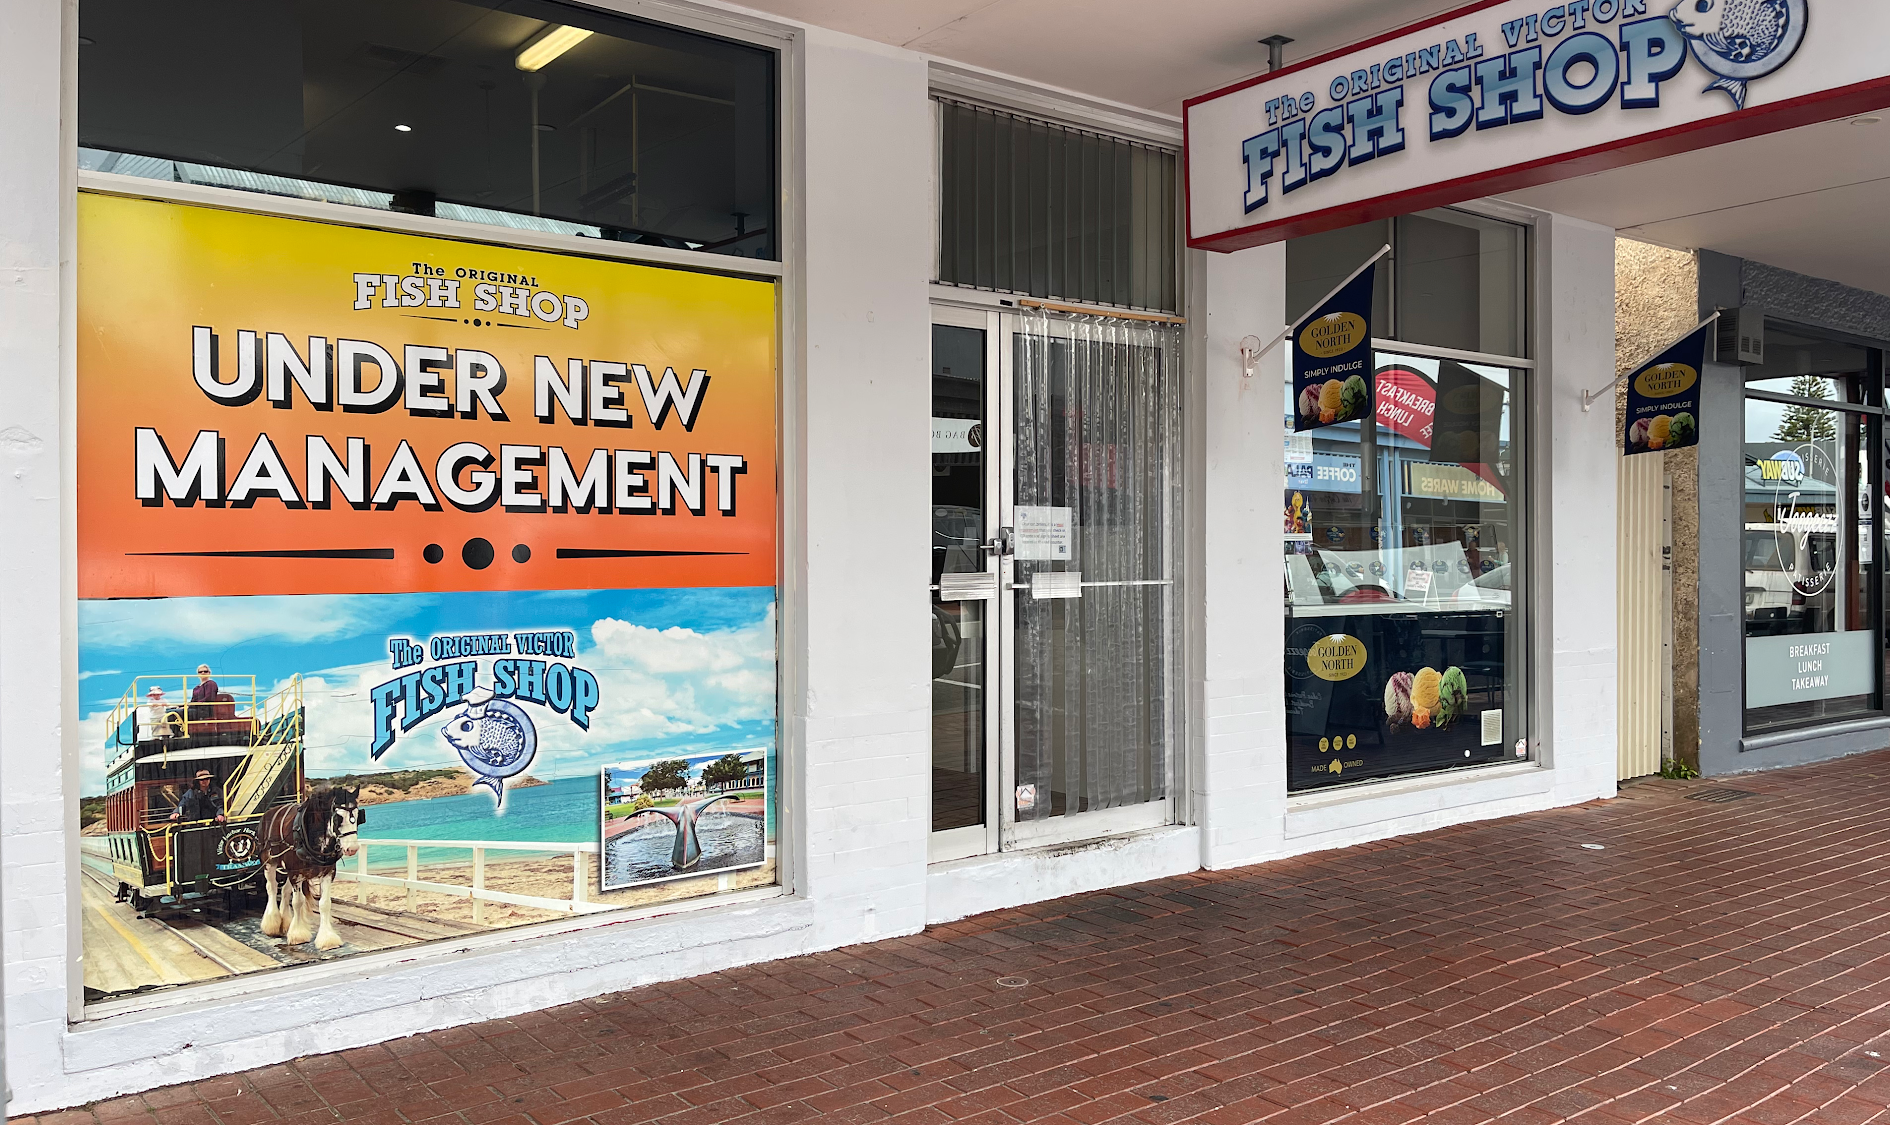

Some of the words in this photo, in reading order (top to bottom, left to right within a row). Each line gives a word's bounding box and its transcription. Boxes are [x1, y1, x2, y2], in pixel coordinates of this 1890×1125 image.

[1264, 93, 1316, 125] The
[1329, 33, 1484, 98] ORIGINAL
[1501, 0, 1647, 48] VICTOR
[1242, 88, 1406, 216] FISH
[1428, 15, 1688, 142] SHOP
[412, 262, 445, 277] The
[455, 267, 540, 288] ORIGINAL
[353, 273, 461, 310] FISH
[474, 283, 590, 330] SHOP
[1310, 319, 1356, 339] GOLDEN
[1315, 333, 1351, 350] NORTH
[191, 324, 510, 422] UNDER
[533, 354, 711, 433] NEW
[1304, 367, 1330, 379] SIMPLY
[1330, 360, 1363, 374] INDULGE
[1645, 370, 1686, 382] GOLDEN
[1648, 380, 1680, 392] NORTH
[1636, 405, 1659, 414] SIMPLY
[1660, 401, 1692, 410] INDULGE
[134, 426, 748, 517] MANAGEMENT
[1788, 562, 1831, 588] PATISSERIE
[390, 639, 423, 669] The
[431, 634, 511, 661] ORIGINAL
[515, 631, 575, 658] VICTOR
[1317, 645, 1358, 658] GOLDEN
[1789, 642, 1831, 658] BREAKFAST
[1321, 658, 1354, 671] NORTH
[1798, 659, 1823, 674] LUNCH
[1791, 674, 1829, 691] TAKEAWAY
[371, 661, 478, 761] FISH
[493, 659, 600, 732] SHOP
[1311, 764, 1327, 773] MADE
[1343, 759, 1364, 769] OWNED
